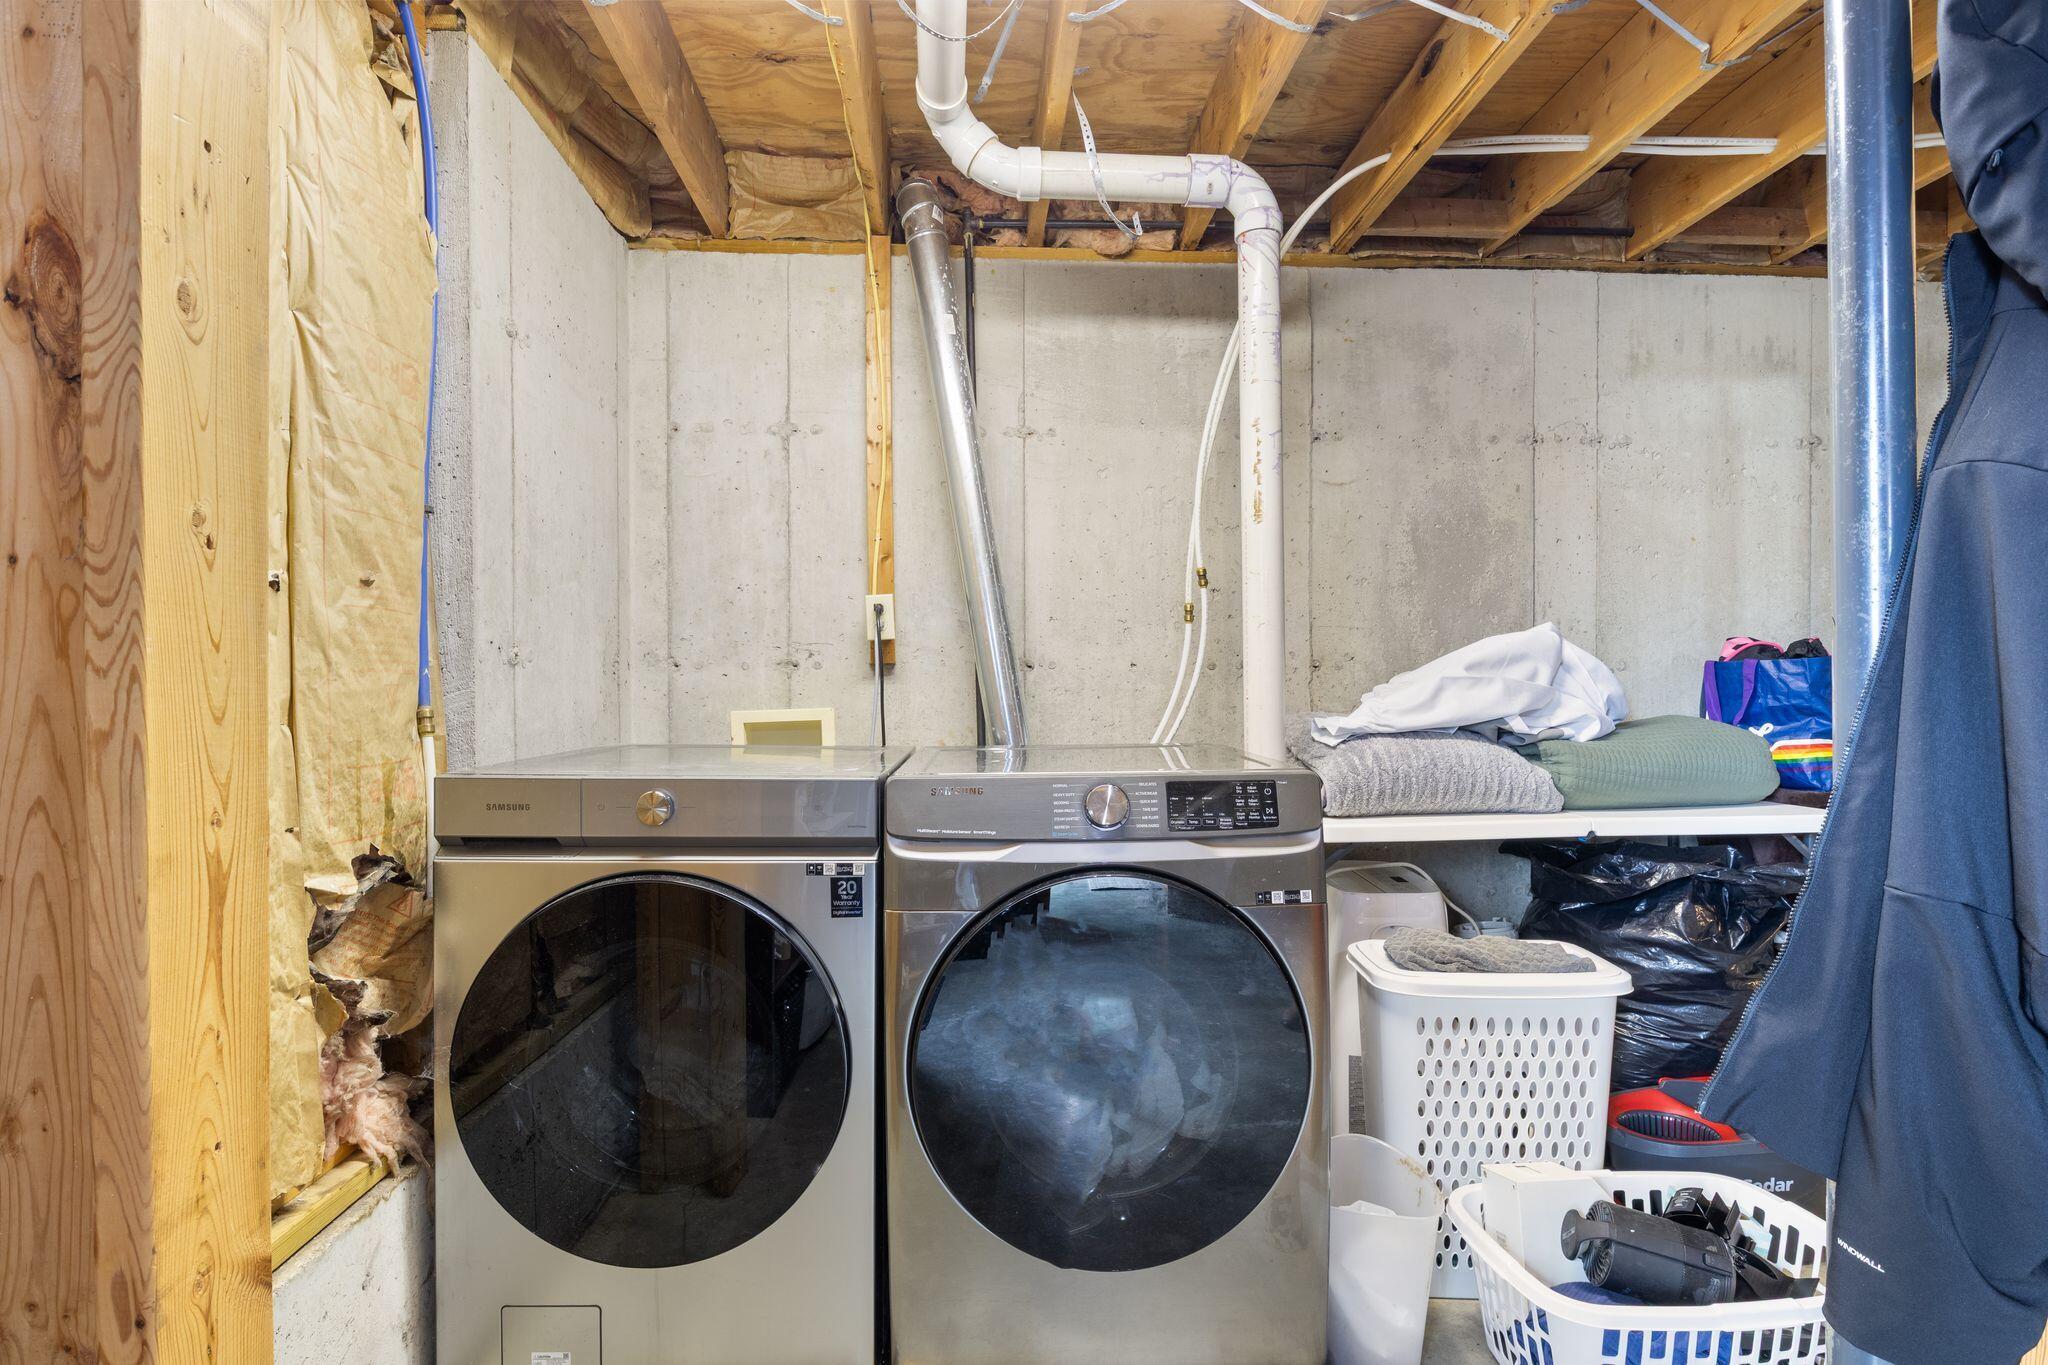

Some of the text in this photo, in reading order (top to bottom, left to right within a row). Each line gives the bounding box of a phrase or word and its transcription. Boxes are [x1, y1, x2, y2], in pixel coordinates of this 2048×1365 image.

[930, 787, 984, 796] SAMSUNG
[486, 802, 530, 811] SAMSUNG
[837, 880, 857, 894] 20
[1837, 1237, 1885, 1273] WINDWALL
